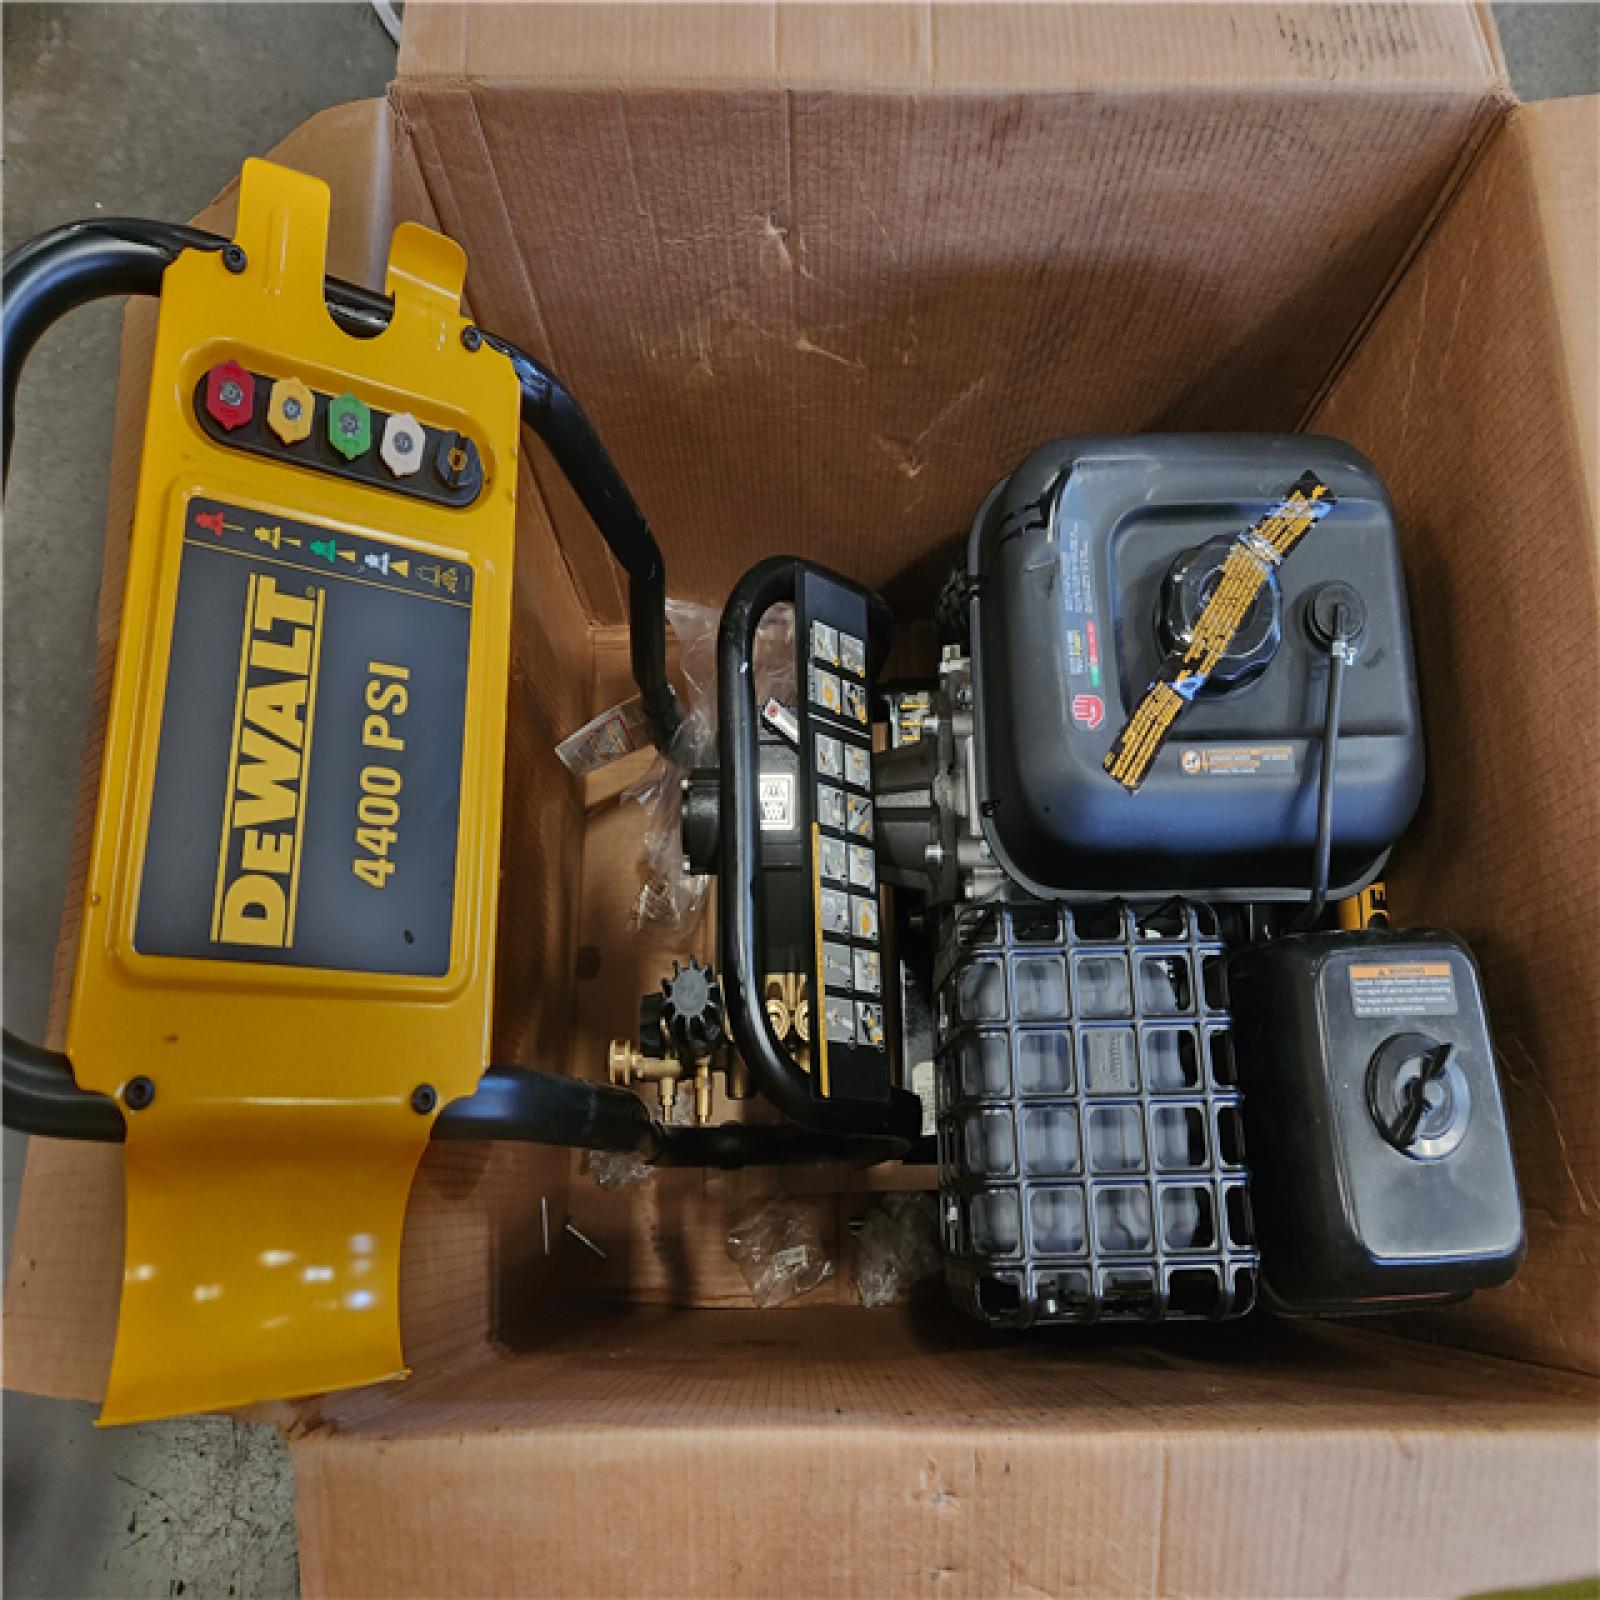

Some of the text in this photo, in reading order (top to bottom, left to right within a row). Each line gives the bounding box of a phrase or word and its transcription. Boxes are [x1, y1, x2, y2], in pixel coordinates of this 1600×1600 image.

[220, 575, 316, 947] DEWALT
[351, 661, 411, 888] 4400 PSI
